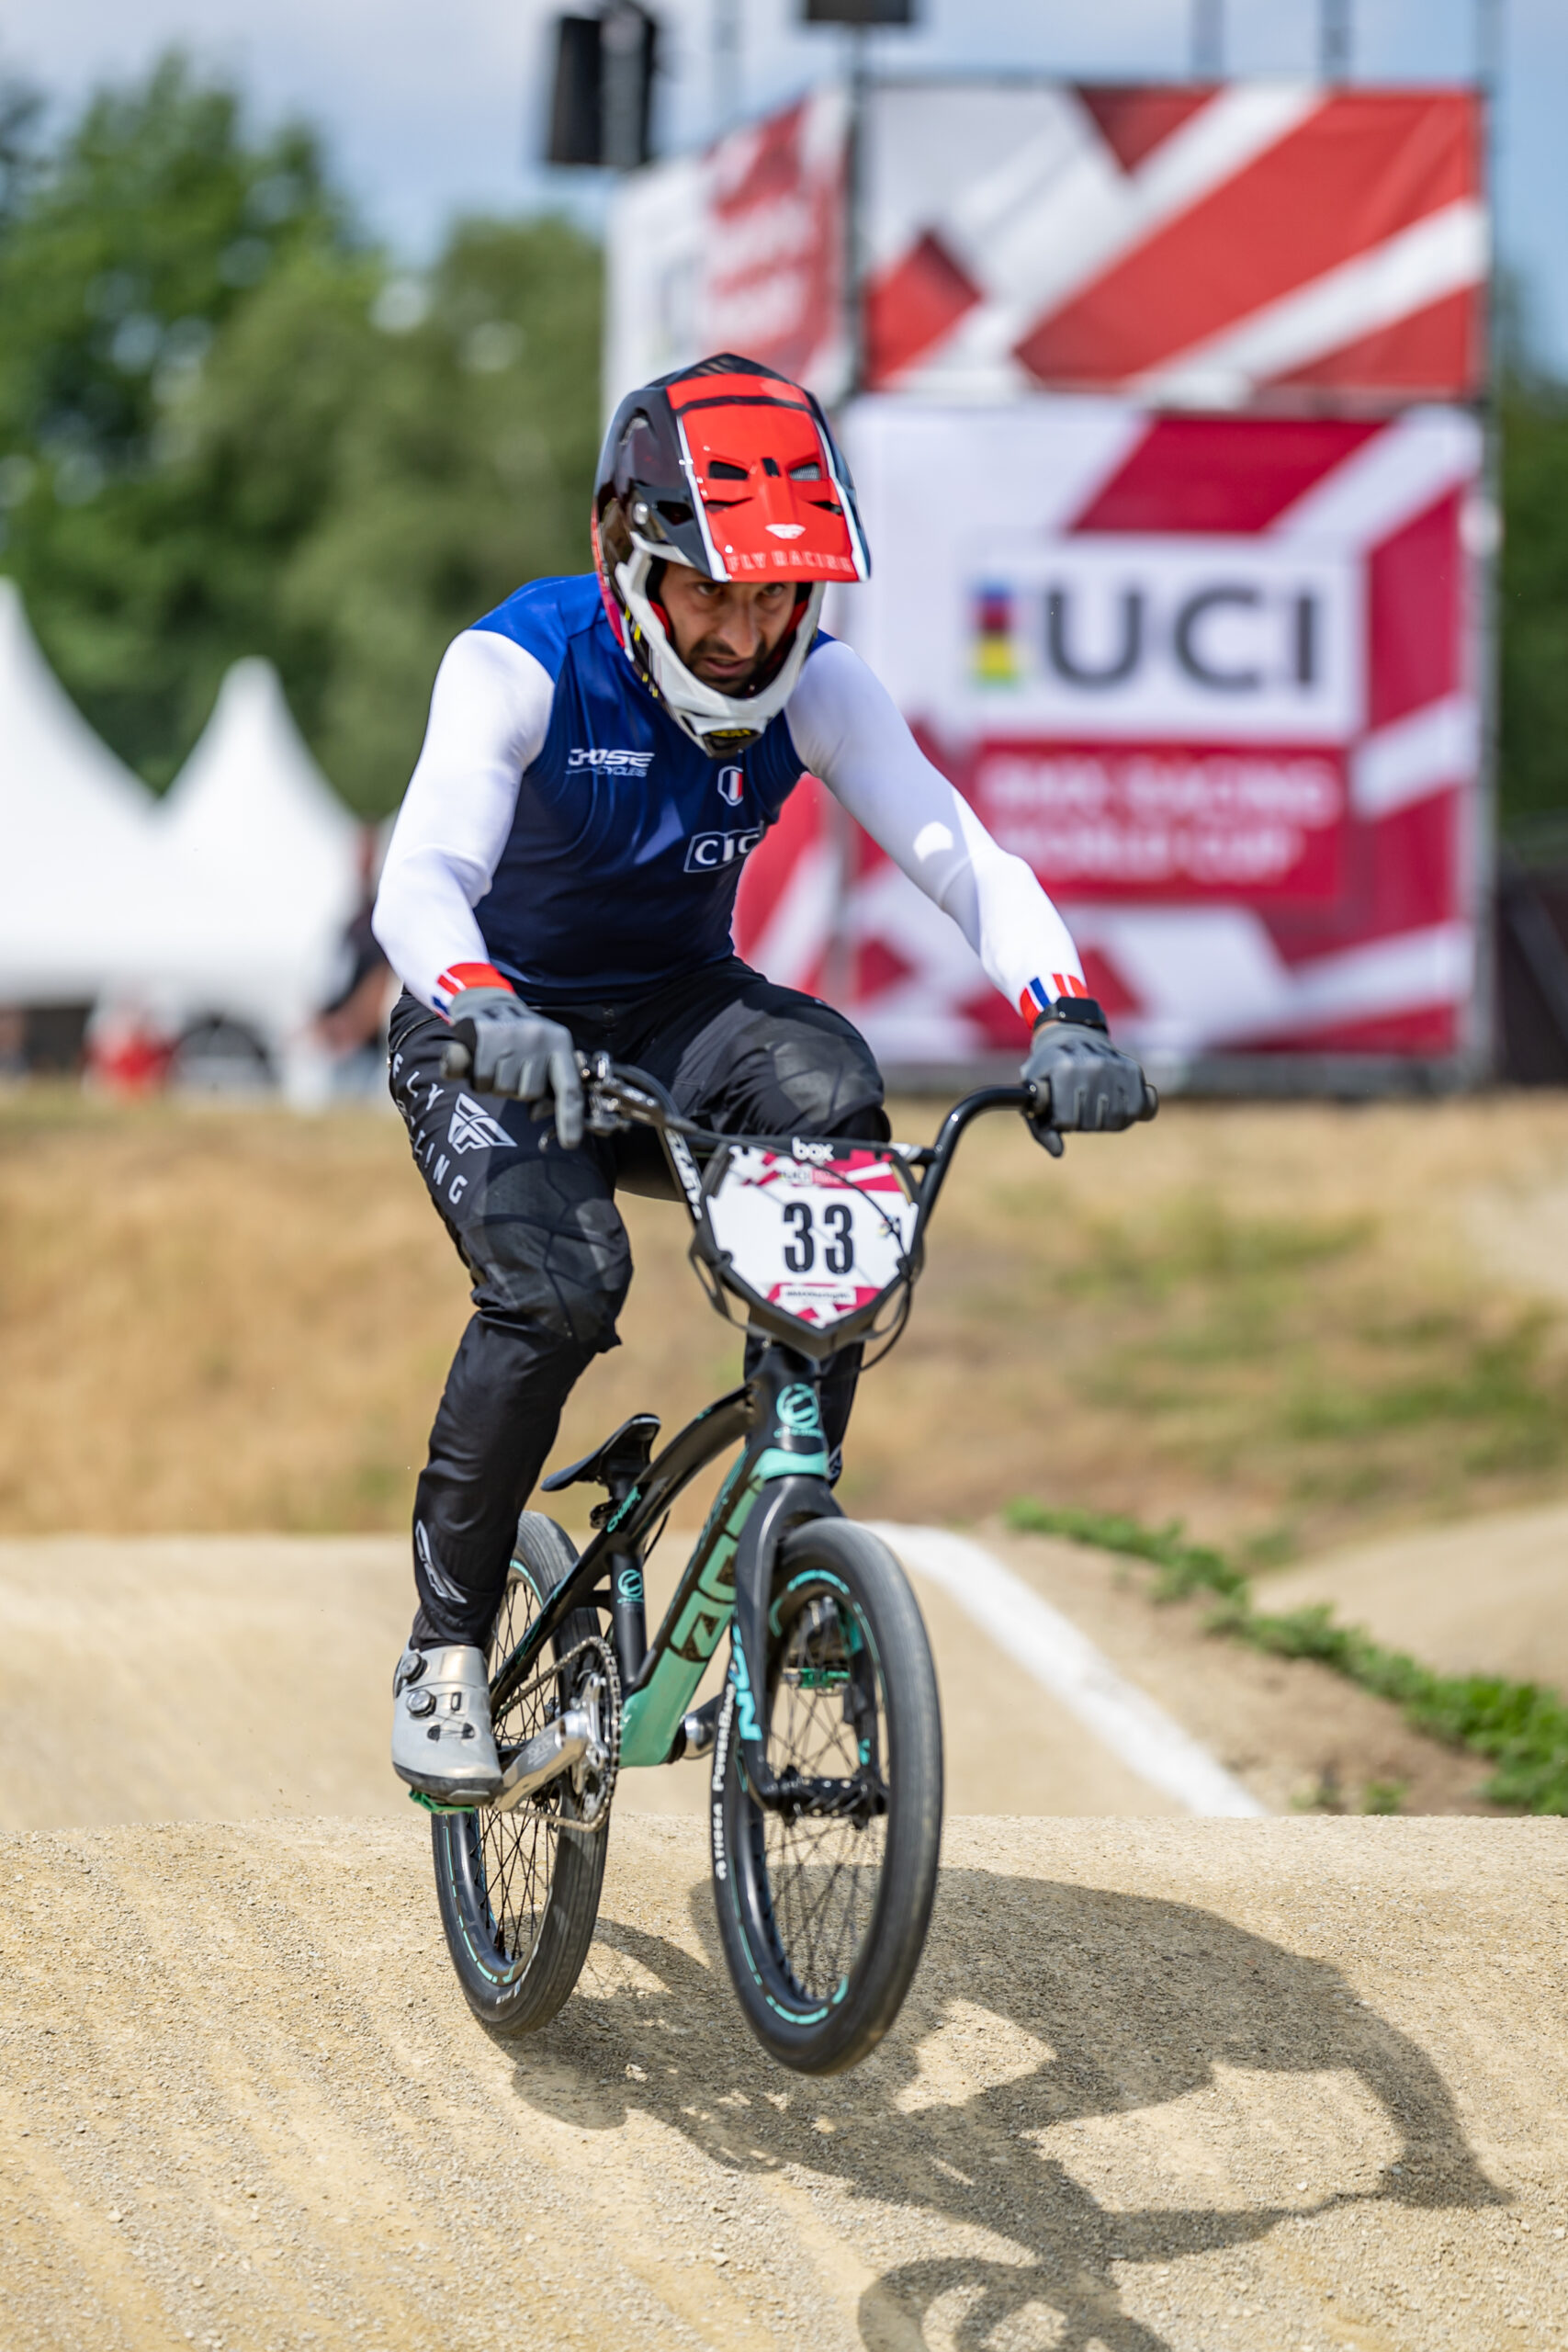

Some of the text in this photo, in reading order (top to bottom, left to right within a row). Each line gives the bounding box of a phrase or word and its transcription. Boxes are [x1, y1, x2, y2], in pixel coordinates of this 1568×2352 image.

[727, 552, 767, 572] FLY
[1044, 582, 1320, 691] UCI
[392, 1053, 445, 1111] FLY
[792, 1136, 835, 1162] box
[784, 1202, 853, 1274] 33
